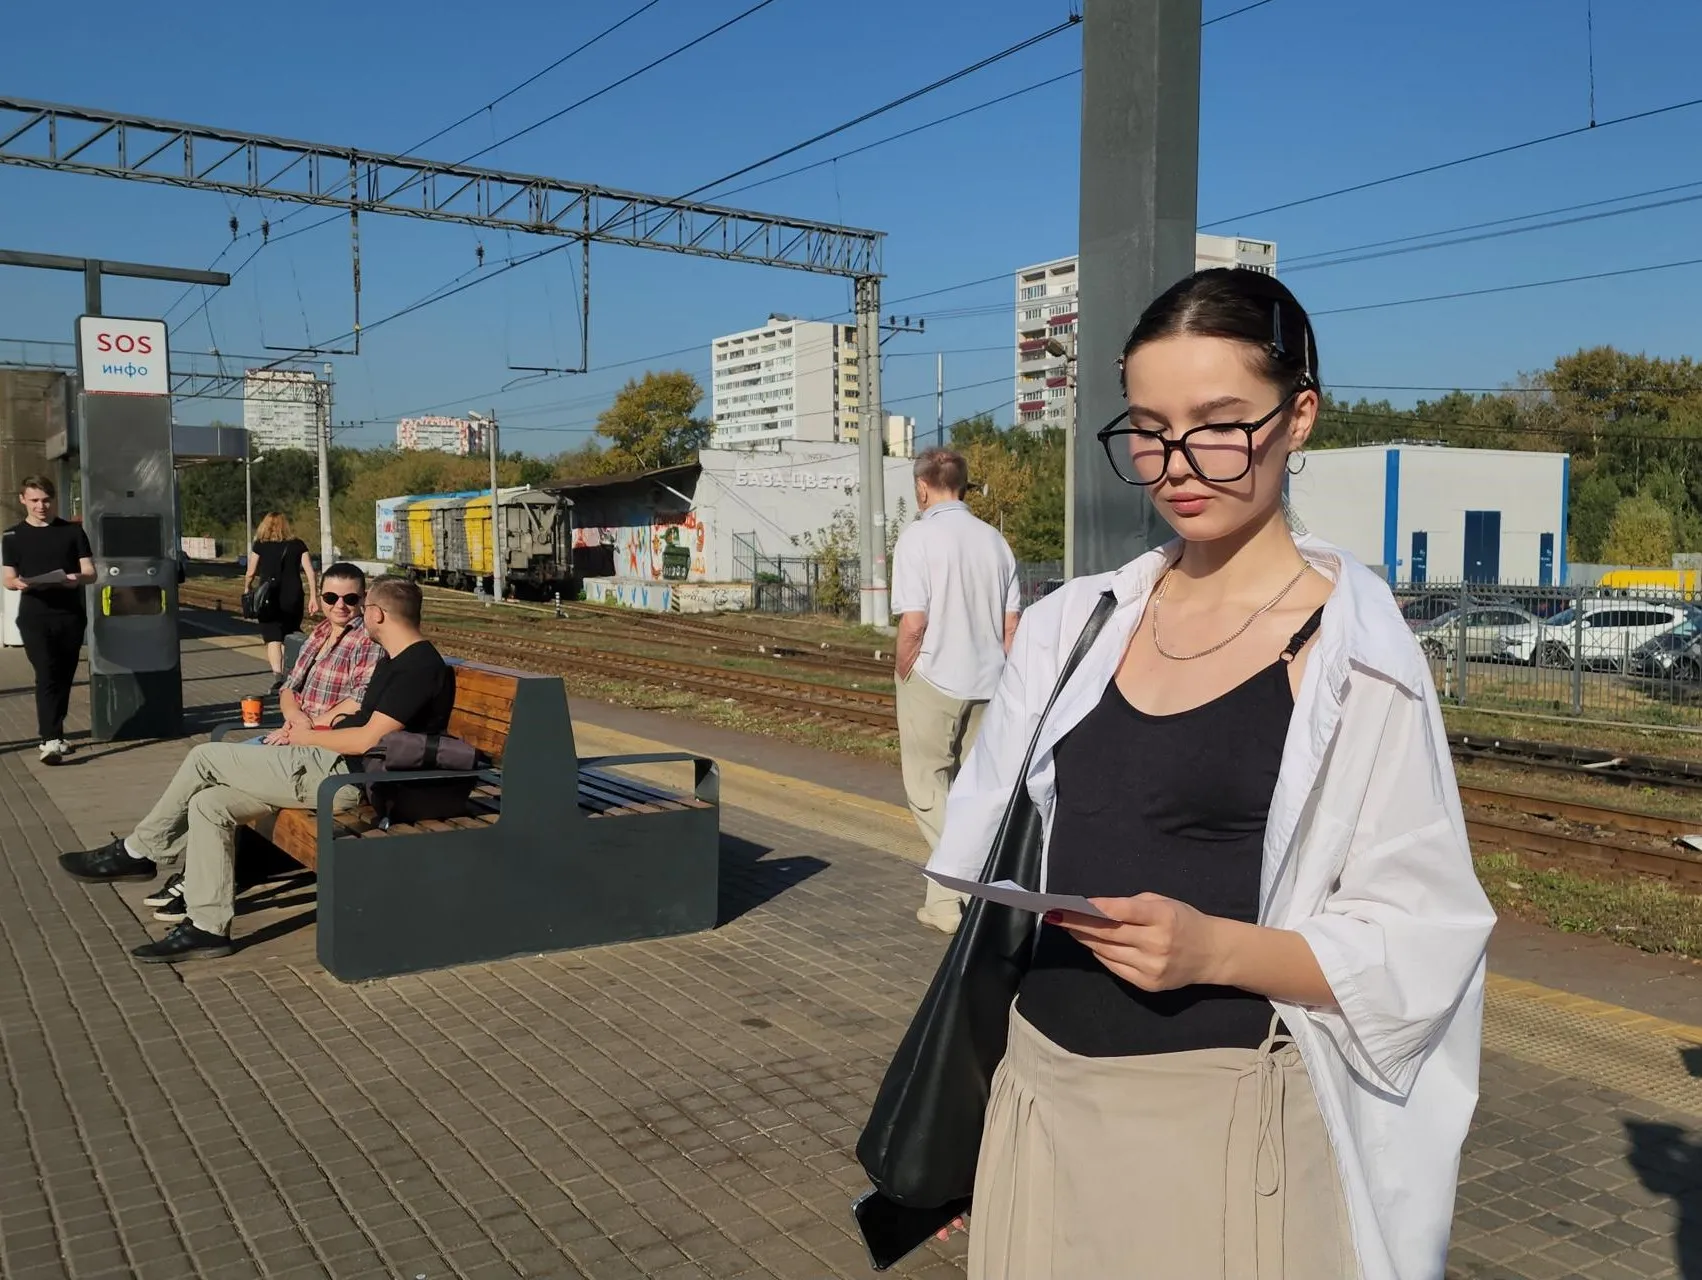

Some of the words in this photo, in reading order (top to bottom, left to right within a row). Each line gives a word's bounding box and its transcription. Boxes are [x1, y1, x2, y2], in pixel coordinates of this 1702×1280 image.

[97, 333, 152, 354] SOS
[102, 362, 148, 378] инфо
[735, 471, 788, 488] БАЗА
[791, 472, 860, 492] ЦВЕТО
